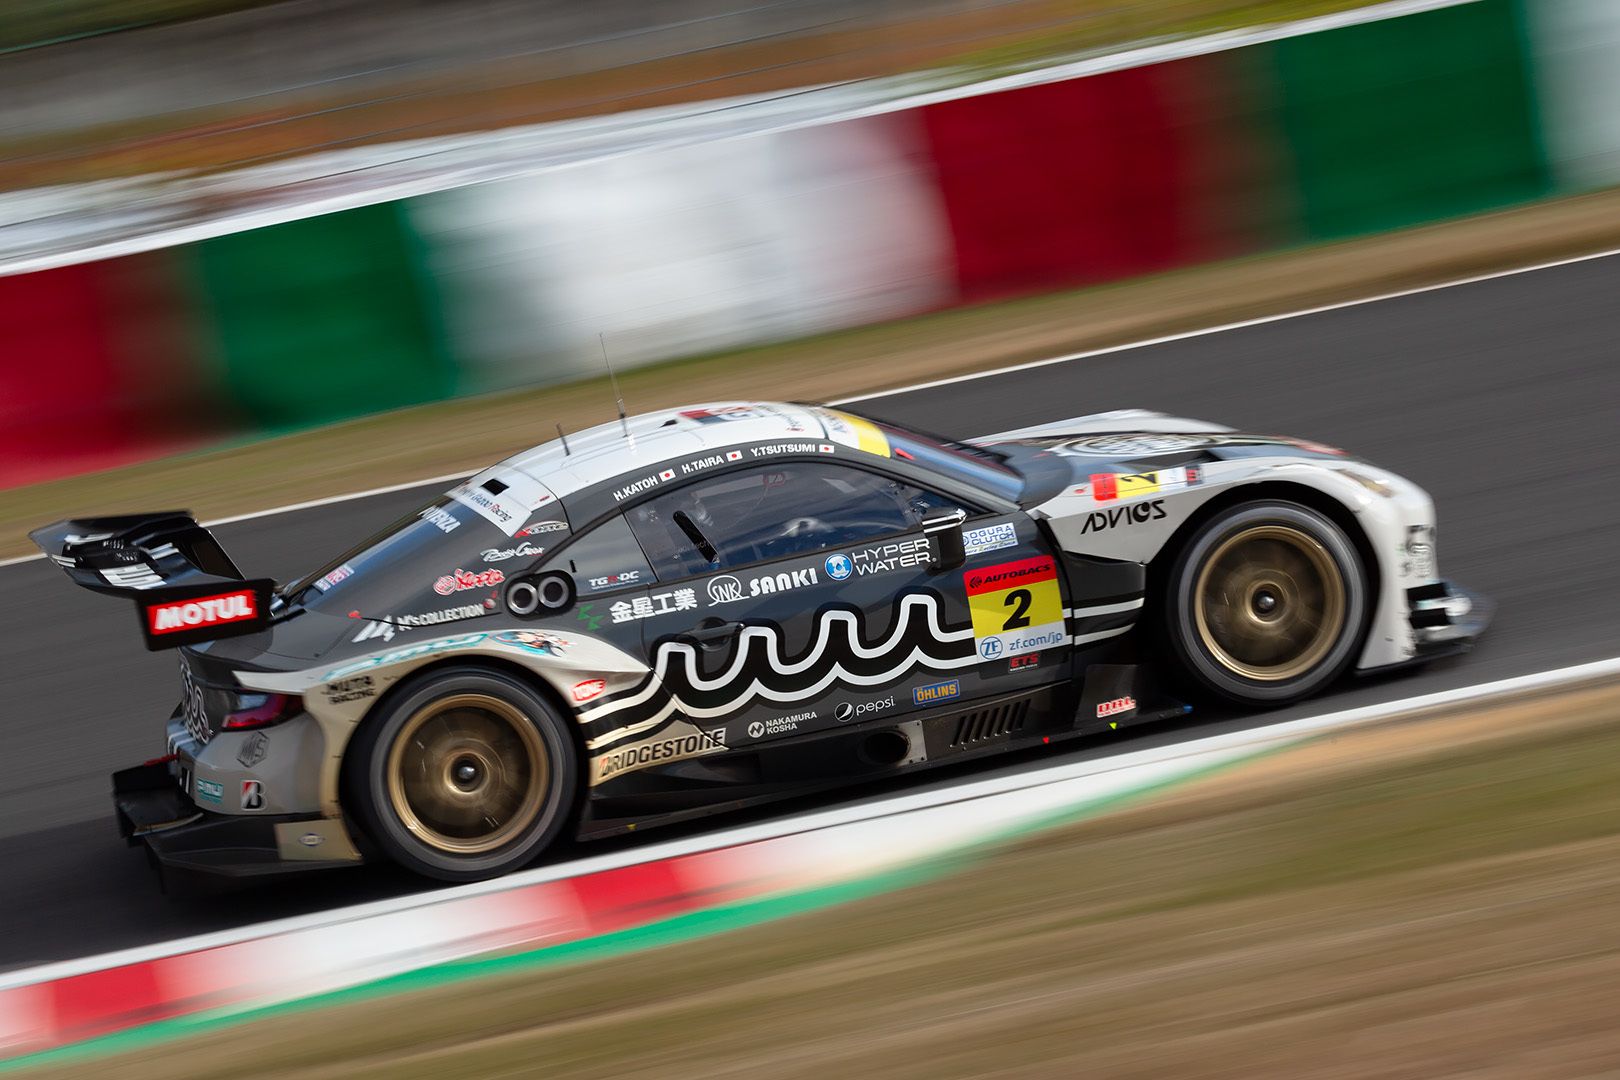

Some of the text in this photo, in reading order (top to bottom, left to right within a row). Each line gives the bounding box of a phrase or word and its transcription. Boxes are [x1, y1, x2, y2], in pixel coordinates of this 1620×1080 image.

[751, 443, 816, 458] Y.TSUTSUMI
[681, 456, 724, 475] H.TAIRA
[613, 475, 659, 502] H.KATOH
[488, 503, 513, 523] Racing
[1081, 499, 1168, 535] ADVICS
[969, 525, 1012, 539] OGURA
[971, 532, 1016, 546] CLUTCH
[852, 538, 931, 563] HYPER
[856, 552, 932, 576] WATER
[983, 563, 1051, 584] AUTOBACS
[750, 567, 819, 598] SANKI
[154, 595, 253, 631] MOTUL
[419, 603, 485, 627] COLLECTION
[609, 588, 698, 624] 金星工業
[1002, 588, 1032, 632] 2
[1009, 632, 1063, 651] zf.com/jp
[1010, 653, 1039, 668] ETS
[573, 681, 605, 701] TONE
[916, 683, 957, 702] ÖHLINS
[856, 696, 895, 716] pepsi
[766, 712, 818, 727] NAKAMURA
[767, 723, 798, 735] KOSHA
[600, 729, 725, 776] BRIDGESTONE
